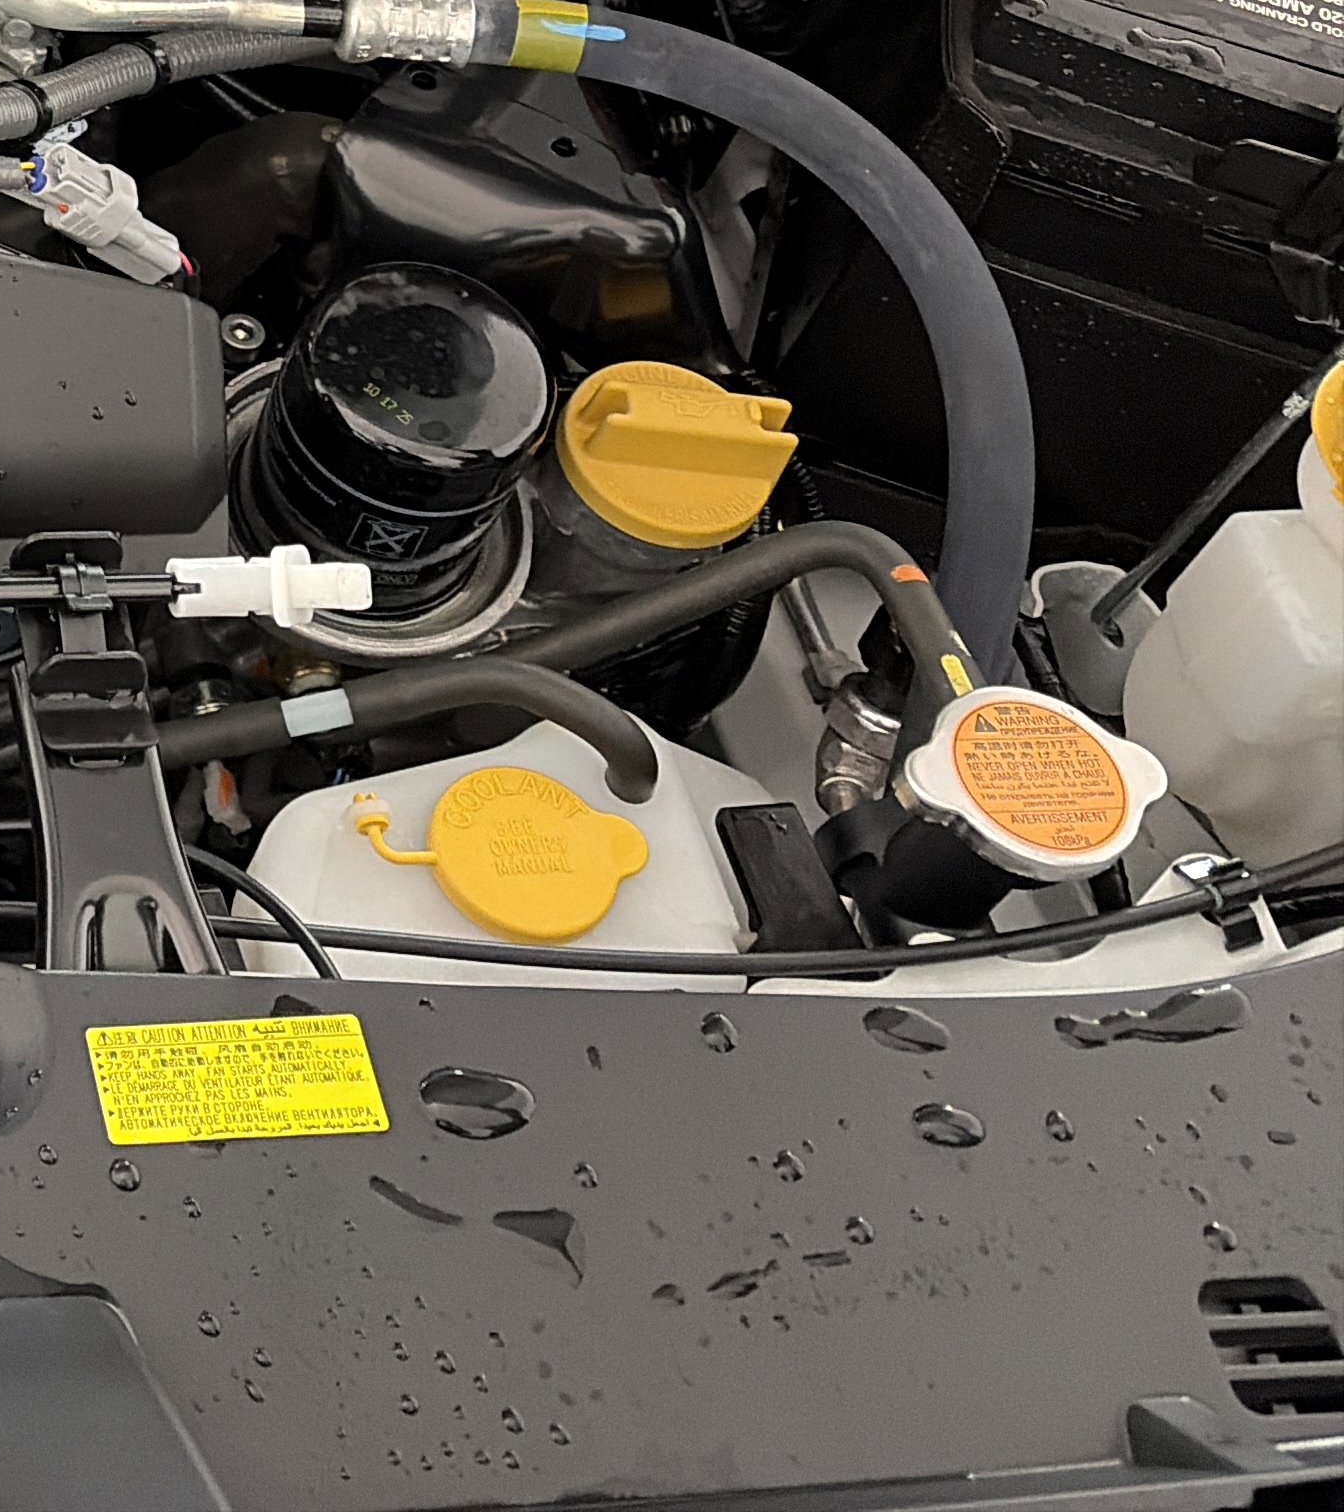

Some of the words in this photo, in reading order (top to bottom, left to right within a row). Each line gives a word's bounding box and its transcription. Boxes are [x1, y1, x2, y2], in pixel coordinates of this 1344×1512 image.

[1311, 21, 1344, 38] OLD
[994, 715, 1060, 727] WARNING
[967, 761, 1004, 772] NEVER
[1007, 761, 1037, 771] OPEN
[1040, 759, 1075, 770] WHEN
[972, 772, 983, 782] NE
[988, 771, 1022, 782] JAMAIS
[1024, 770, 1061, 781] OUVRIR
[445, 772, 589, 829] COOLANT
[1011, 811, 1109, 825] AVERTISSEMENT
[496, 819, 536, 837] SEE
[494, 855, 573, 876] MANUAL
[142, 1027, 186, 1044] CAUTION
[192, 1023, 247, 1041] ATTENTION
[292, 1019, 351, 1036] ВНИМАНИЕ
[108, 1071, 132, 1083] KEEP
[137, 1070, 167, 1080] HANDS
[206, 1067, 225, 1078] FAN
[231, 1064, 265, 1076] STARTS
[111, 1083, 123, 1095] LE
[128, 1080, 177, 1093] DÉMARRAGE
[184, 1079, 196, 1090] DU
[201, 1075, 263, 1089] VENTILATEUR
[303, 1071, 370, 1084] AUTOMATIQUE.
[113, 1095, 140, 1106] N'EN
[145, 1091, 200, 1104] APPROCHEZ
[206, 1089, 225, 1101] PAS
[231, 1088, 249, 1100] LES
[255, 1086, 293, 1099] MAINS.
[118, 1106, 167, 1119] ДЕРЖИТЕ
[171, 1104, 200, 1115] РУКИ
[203, 1103, 210, 1113] В
[120, 1115, 221, 1130] АВТОМАТИЧЕСКОЕ
[225, 1110, 289, 1124] ВКЛЮЧЕНИЕ
[293, 1106, 378, 1120] ВЕНТИЛЯТОРА.
